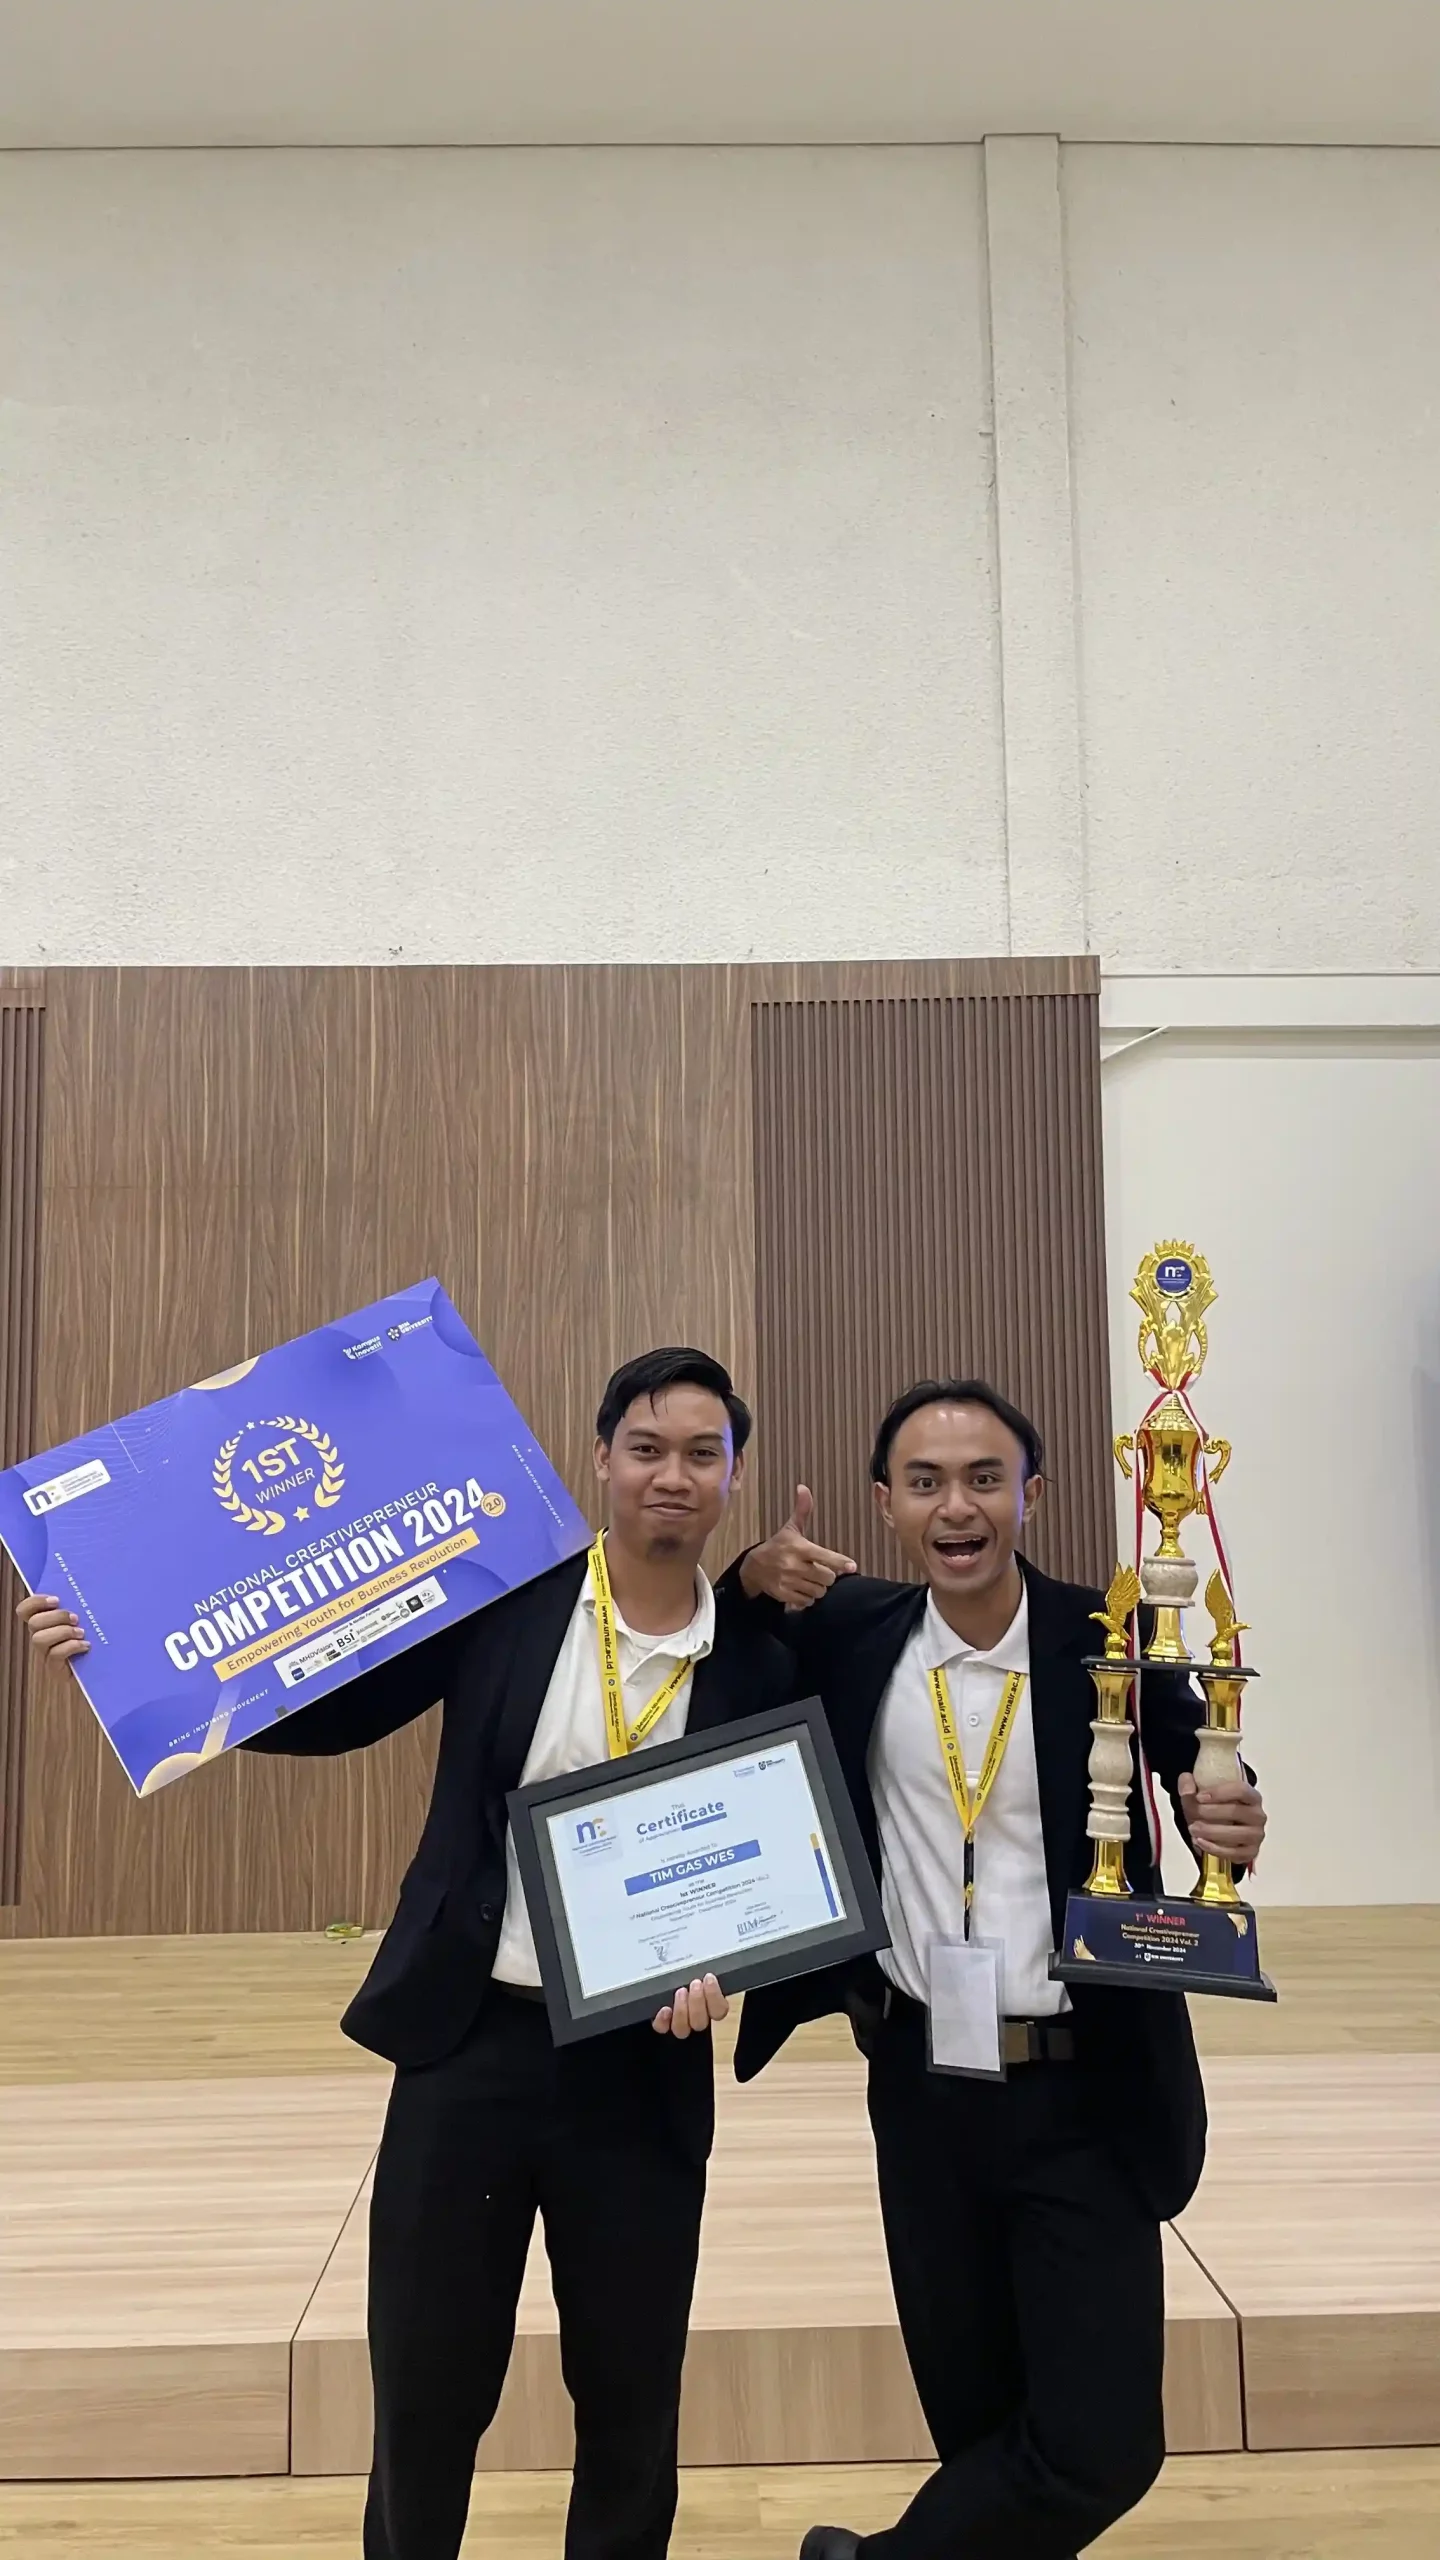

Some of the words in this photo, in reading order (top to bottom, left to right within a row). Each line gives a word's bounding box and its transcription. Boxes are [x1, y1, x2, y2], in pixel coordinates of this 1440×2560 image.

[352, 1335, 380, 1352] Kampus
[241, 1437, 301, 1484] 1ST
[255, 1467, 316, 1504] WINNER
[485, 1497, 501, 1512] 2.0
[193, 1564, 284, 1616] NATIONAL
[285, 1482, 440, 1569] CREATIVEPRENEUR
[164, 1523, 405, 1671] COMPETITION
[403, 1477, 485, 1547] 2024
[54, 1552, 69, 1572] BRING
[66, 1574, 88, 1608] INSPIRING
[85, 1609, 109, 1645] MOVEMENT
[227, 1625, 302, 1672] Empowering
[302, 1606, 337, 1632] Youth
[338, 1595, 356, 1612] for
[358, 1571, 408, 1601] Business
[409, 1537, 468, 1573] Revolution
[602, 1605, 614, 1670] www.unair.ac.id
[168, 1732, 190, 1747] BRING
[193, 1711, 229, 1733] INSPIRING
[231, 1688, 269, 1712] MOVEMENT
[932, 1668, 951, 1734] www.unair.ac.id
[998, 1672, 1021, 1736] www.unair.ac.id
[636, 1801, 724, 1835] Certificate
[650, 1869, 673, 1884] TIM
[676, 1860, 702, 1876] GAS
[704, 1849, 735, 1867] WES
[690, 1882, 716, 1895] WINNER
[636, 1908, 660, 1919] National
[1121, 1924, 1148, 1933] National
[1146, 1914, 1186, 1926] WINNER
[1122, 1932, 1160, 1942] Competition
[1161, 1936, 1179, 1944] 2024
